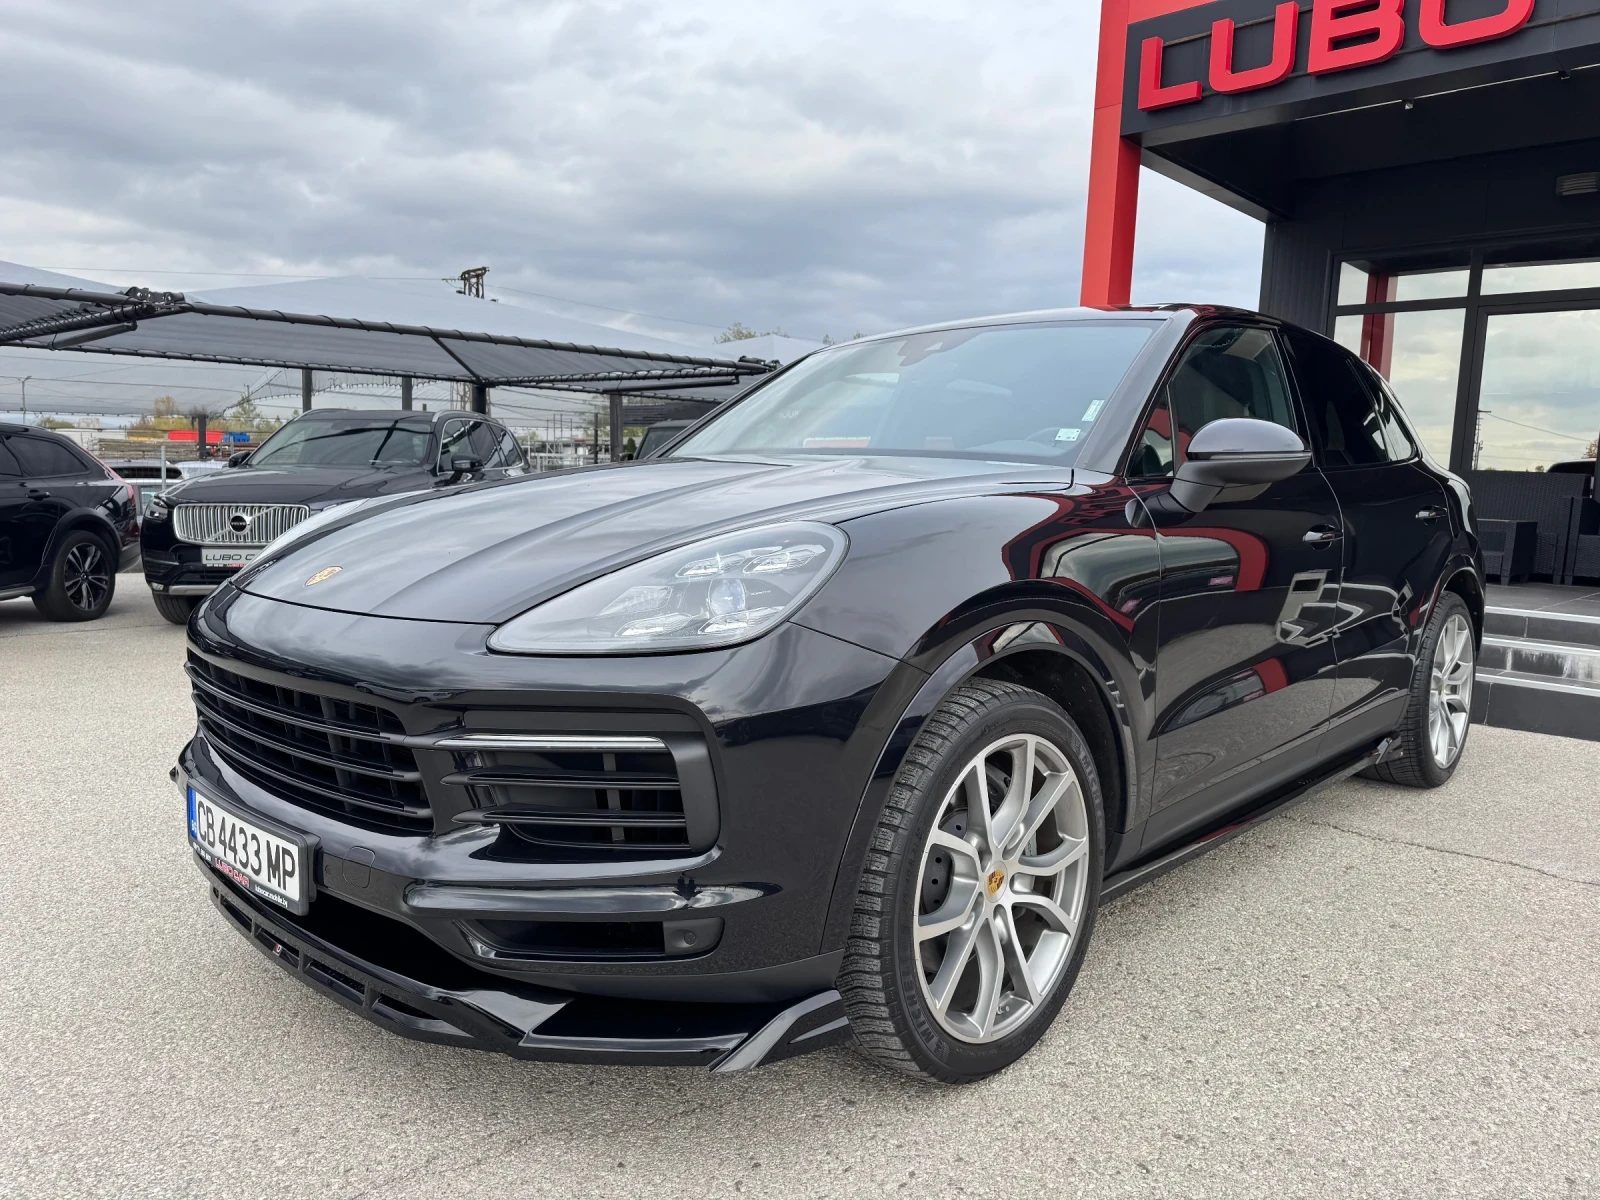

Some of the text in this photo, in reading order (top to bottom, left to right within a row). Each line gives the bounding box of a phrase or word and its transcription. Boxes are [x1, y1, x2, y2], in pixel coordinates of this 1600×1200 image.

[1138, 0, 1534, 112] LUBO
[205, 553, 242, 561] LUBO
[197, 800, 216, 849] CB
[218, 816, 263, 877] 4433
[266, 840, 296, 891] MP
